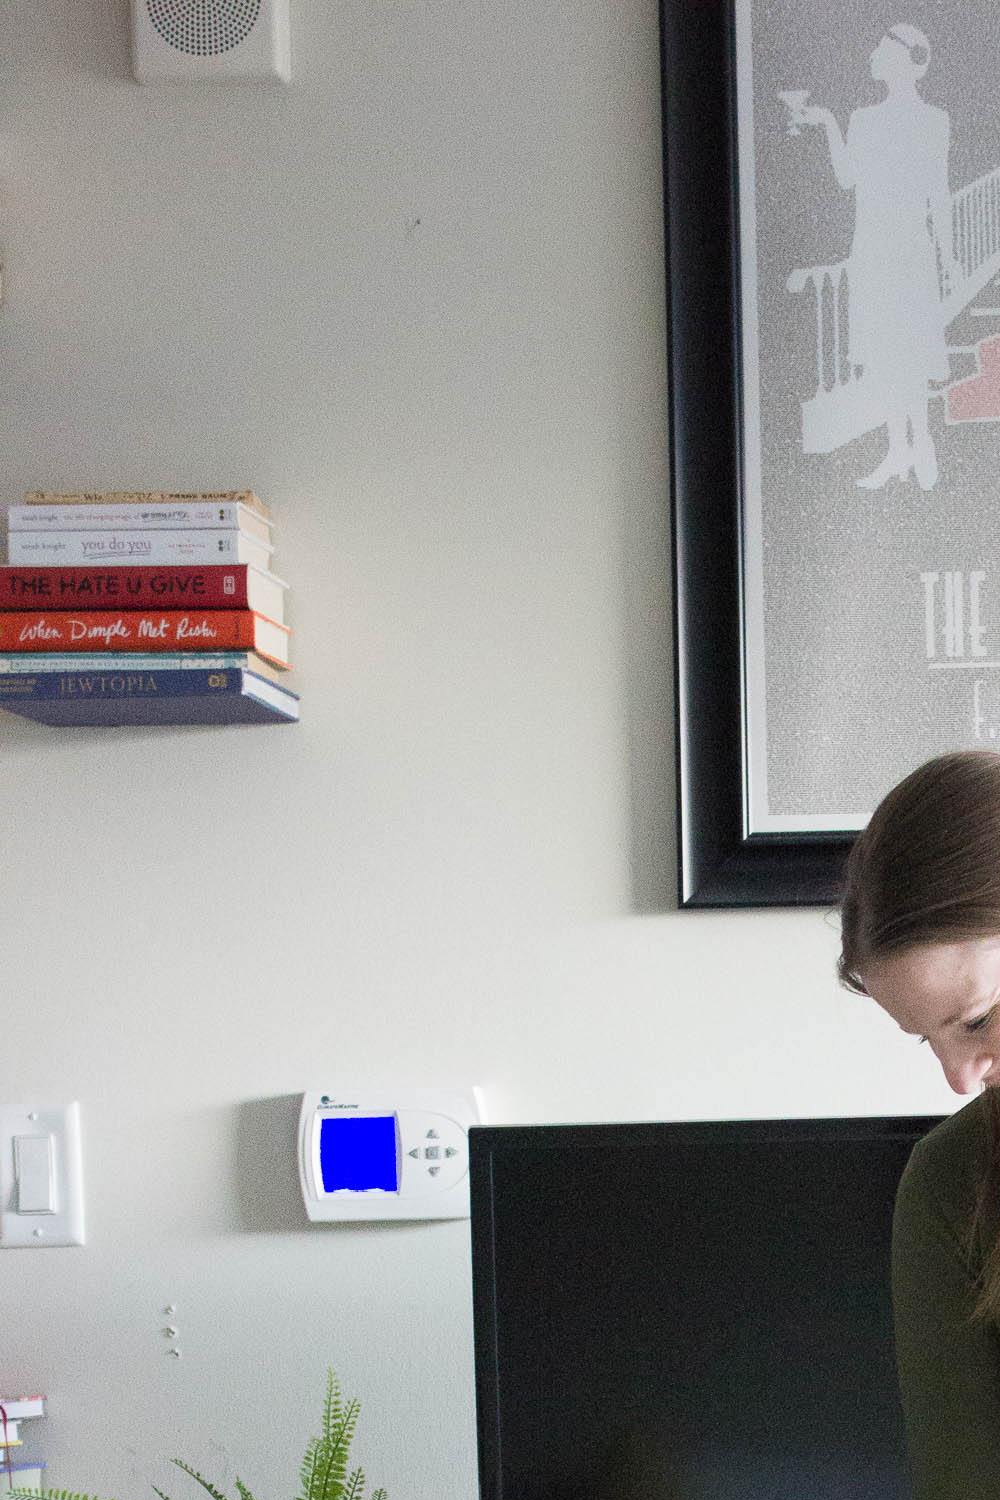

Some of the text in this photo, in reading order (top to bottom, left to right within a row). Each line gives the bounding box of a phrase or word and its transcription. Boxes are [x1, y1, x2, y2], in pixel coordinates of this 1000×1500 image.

[81, 539, 105, 551] you
[108, 537, 125, 551] do
[127, 538, 152, 553] you
[8, 575, 206, 596] THE HATE U GIVE
[921, 571, 987, 658] THE
[19, 619, 62, 642] When
[67, 619, 132, 645] Dimple
[137, 619, 167, 639] Met
